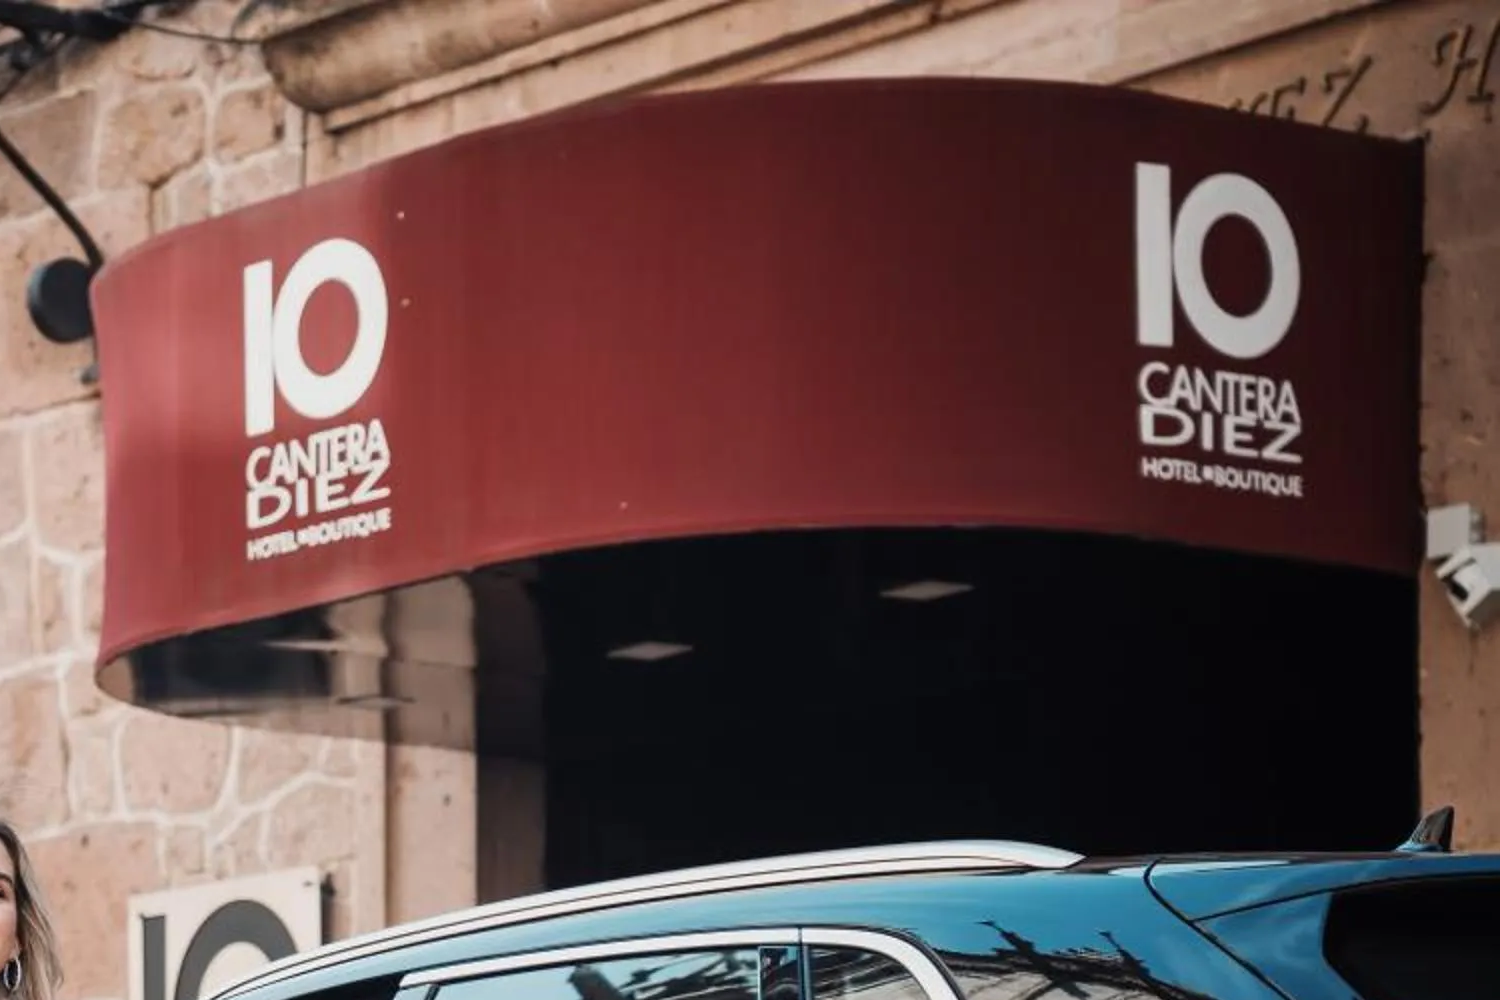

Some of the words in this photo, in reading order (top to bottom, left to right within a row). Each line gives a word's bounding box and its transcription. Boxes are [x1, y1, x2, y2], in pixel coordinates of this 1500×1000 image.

[1138, 361, 1301, 424] CANTERA
[245, 418, 390, 491] CANTERA
[1138, 403, 1303, 463] DIEZ
[246, 462, 391, 529] DIEZ
[1140, 456, 1202, 484] HOTEL
[1212, 464, 1303, 498] BOUTIQUE
[247, 530, 299, 561] HOTEL
